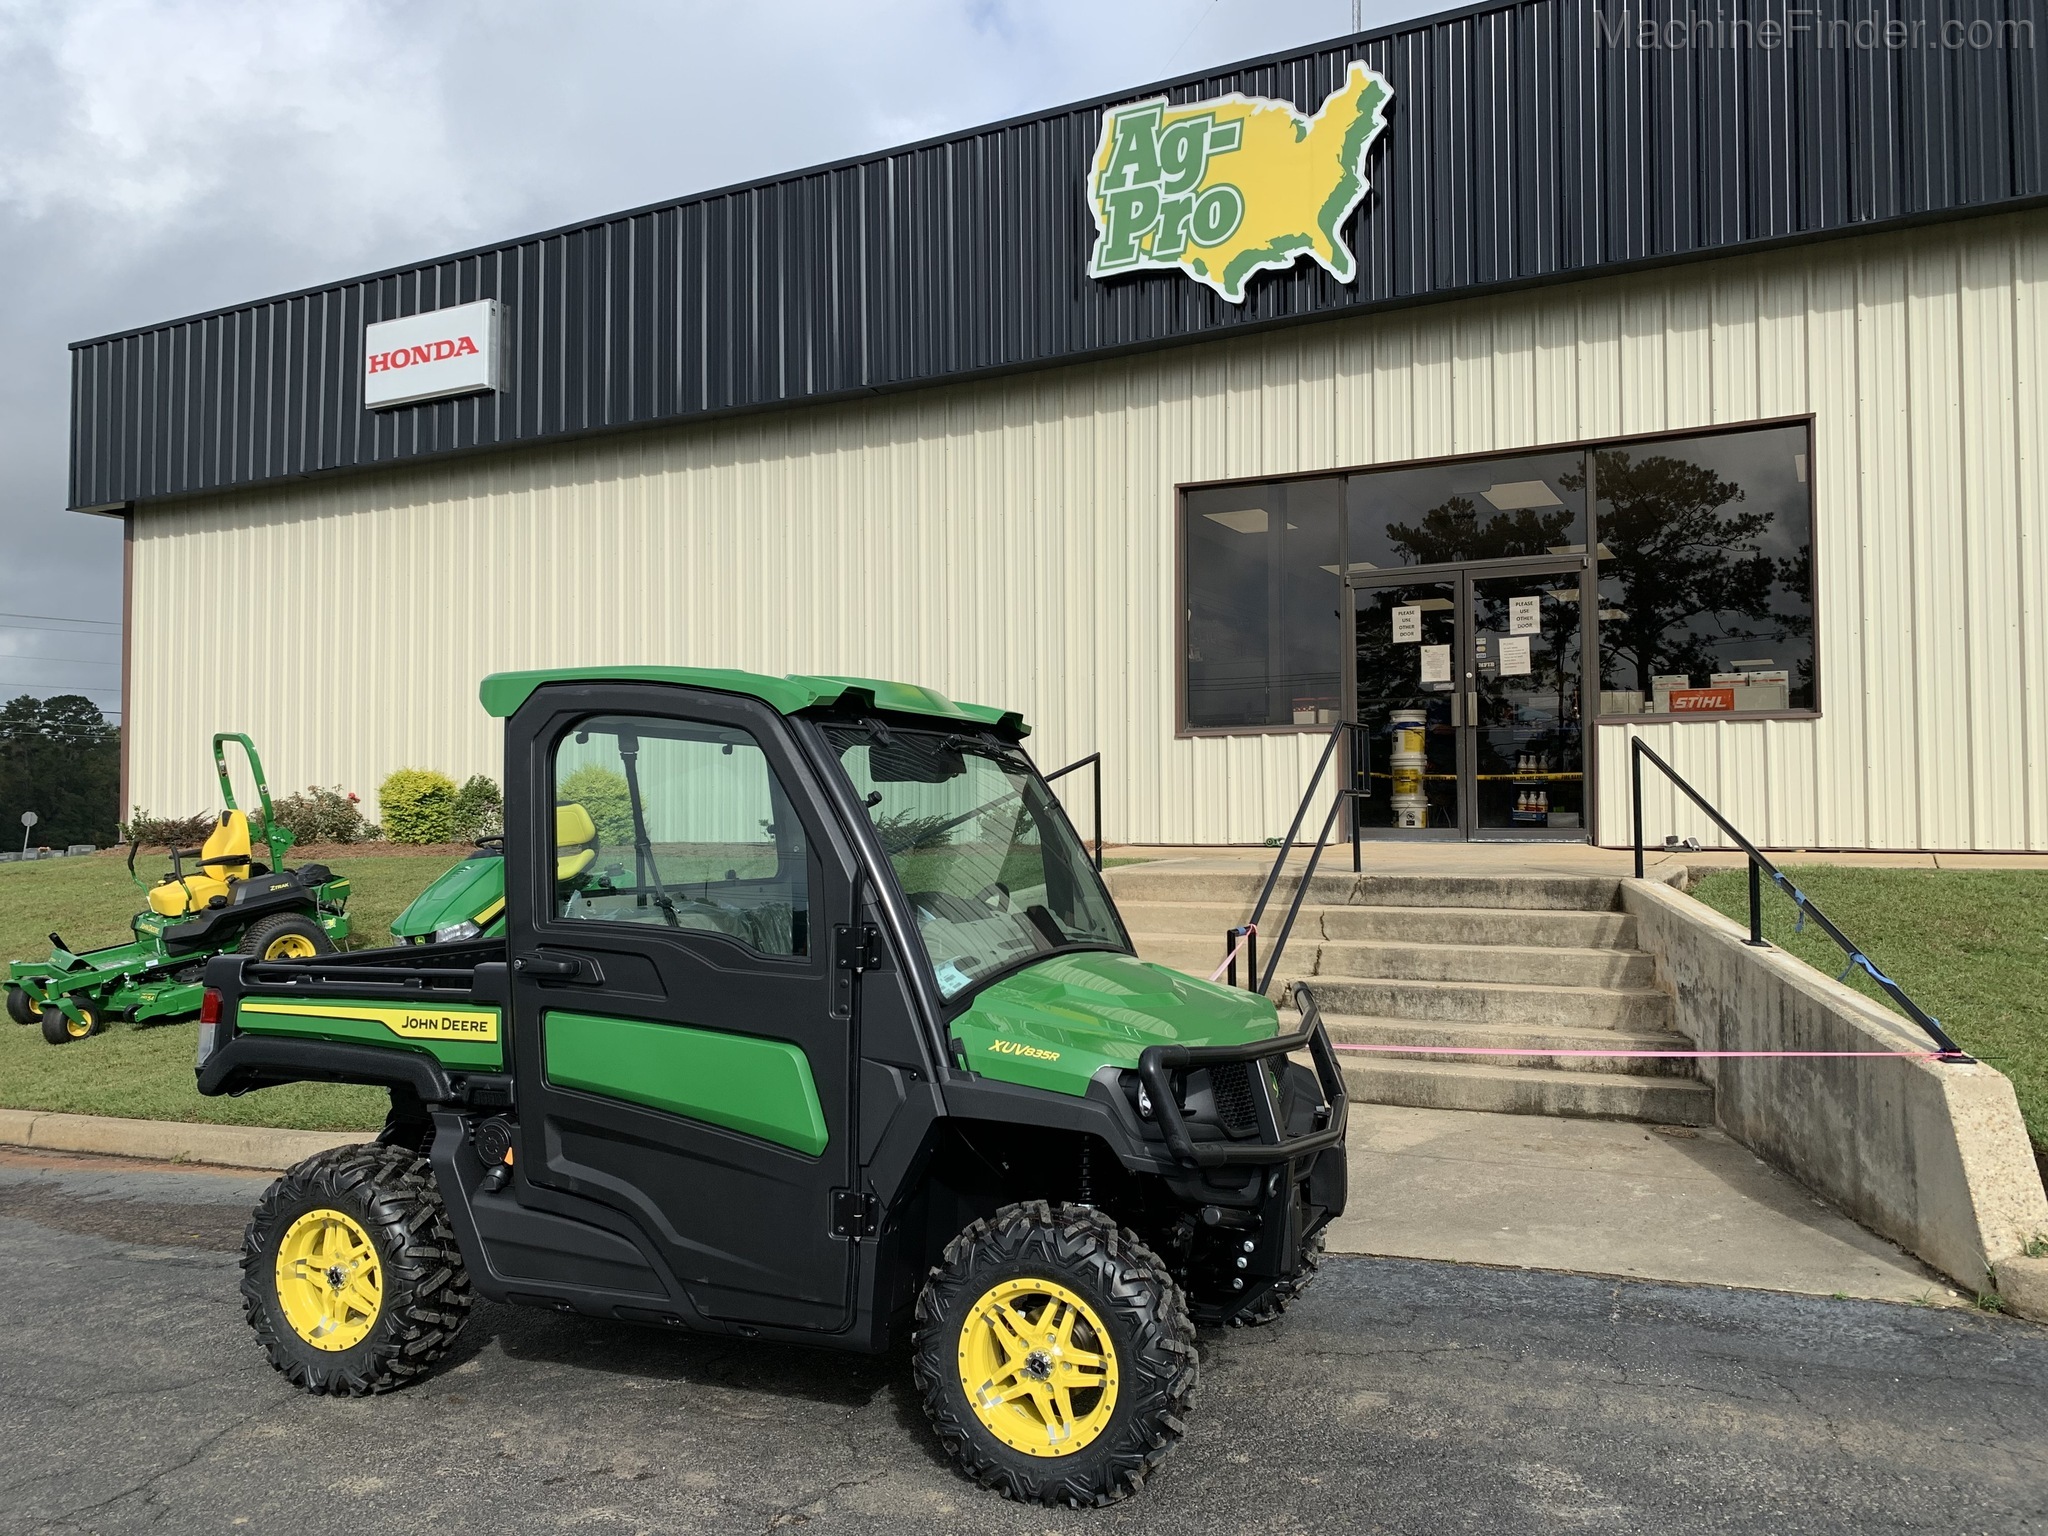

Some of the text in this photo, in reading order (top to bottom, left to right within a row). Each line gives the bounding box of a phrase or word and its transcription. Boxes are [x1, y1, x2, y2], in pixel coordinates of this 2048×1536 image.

[1099, 105, 1243, 195] Ag-
[1099, 183, 1243, 270] Pro
[368, 336, 479, 374] HONDA
[1674, 696, 1727, 709] STIHL
[402, 1016, 488, 1032] JOHN DEERE
[988, 1040, 1060, 1062] XUV835R
